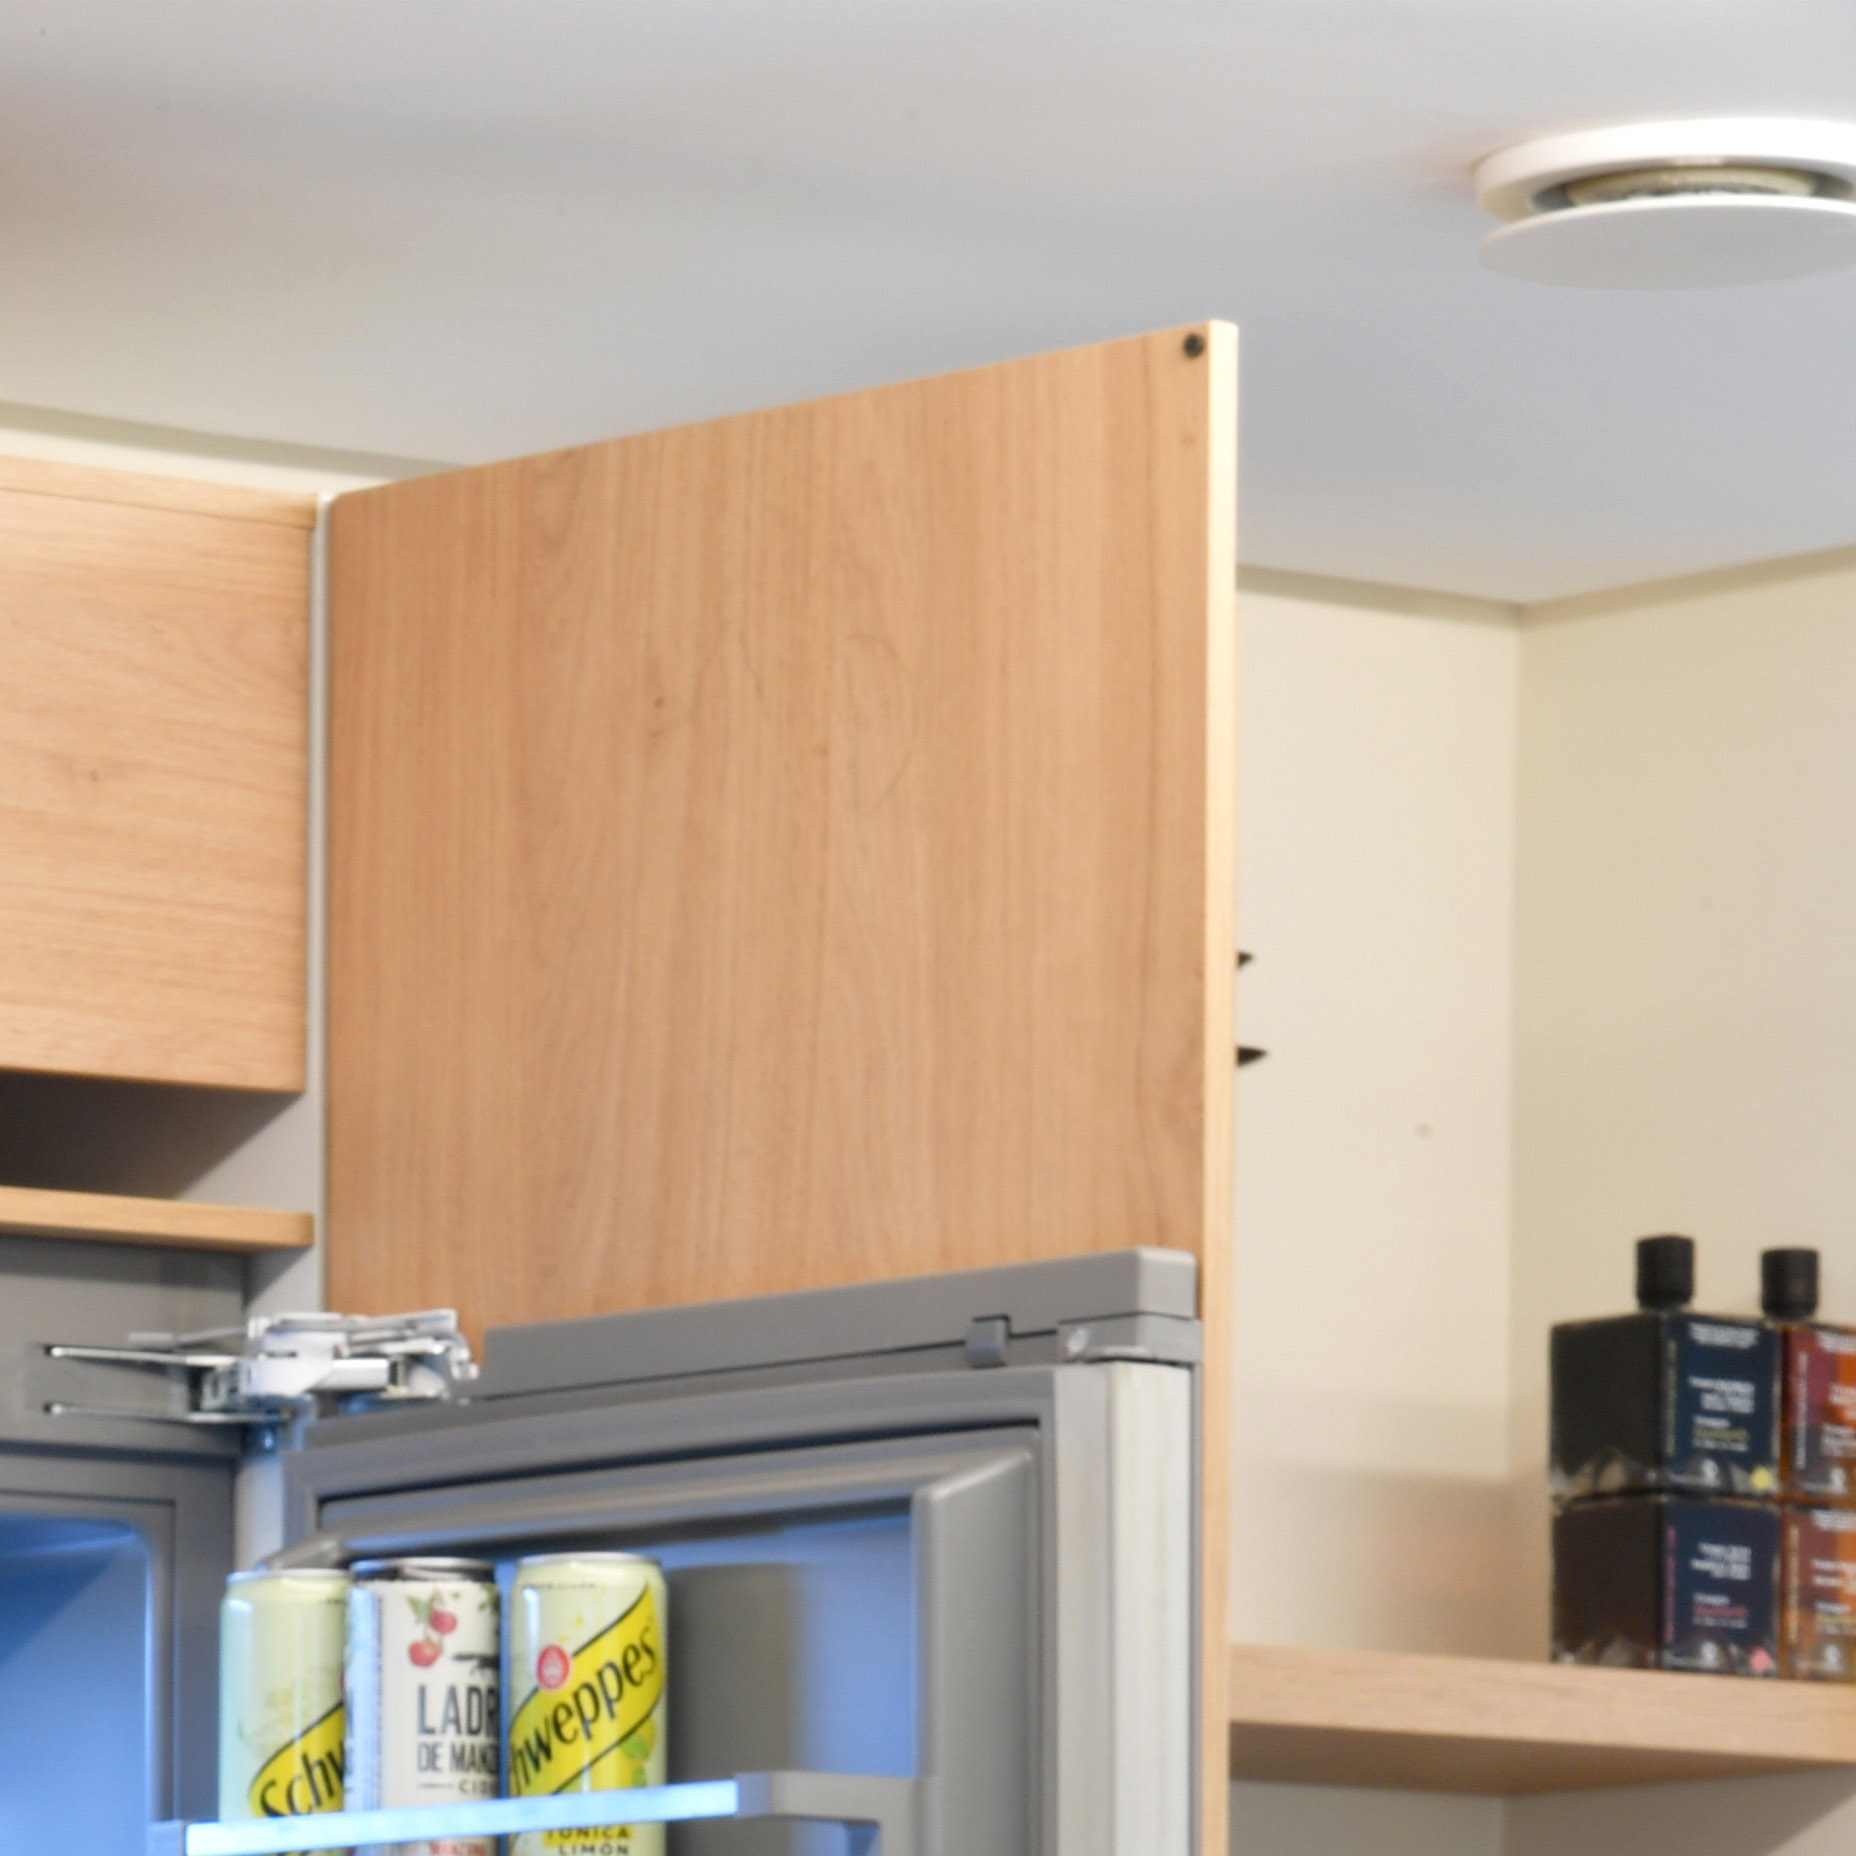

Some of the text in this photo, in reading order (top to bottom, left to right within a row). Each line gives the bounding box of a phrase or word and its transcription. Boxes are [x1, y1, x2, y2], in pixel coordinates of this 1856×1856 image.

[417, 1684, 499, 1736] LADR
[510, 1627, 657, 1797] hweppes
[417, 1742, 443, 1773] DE
